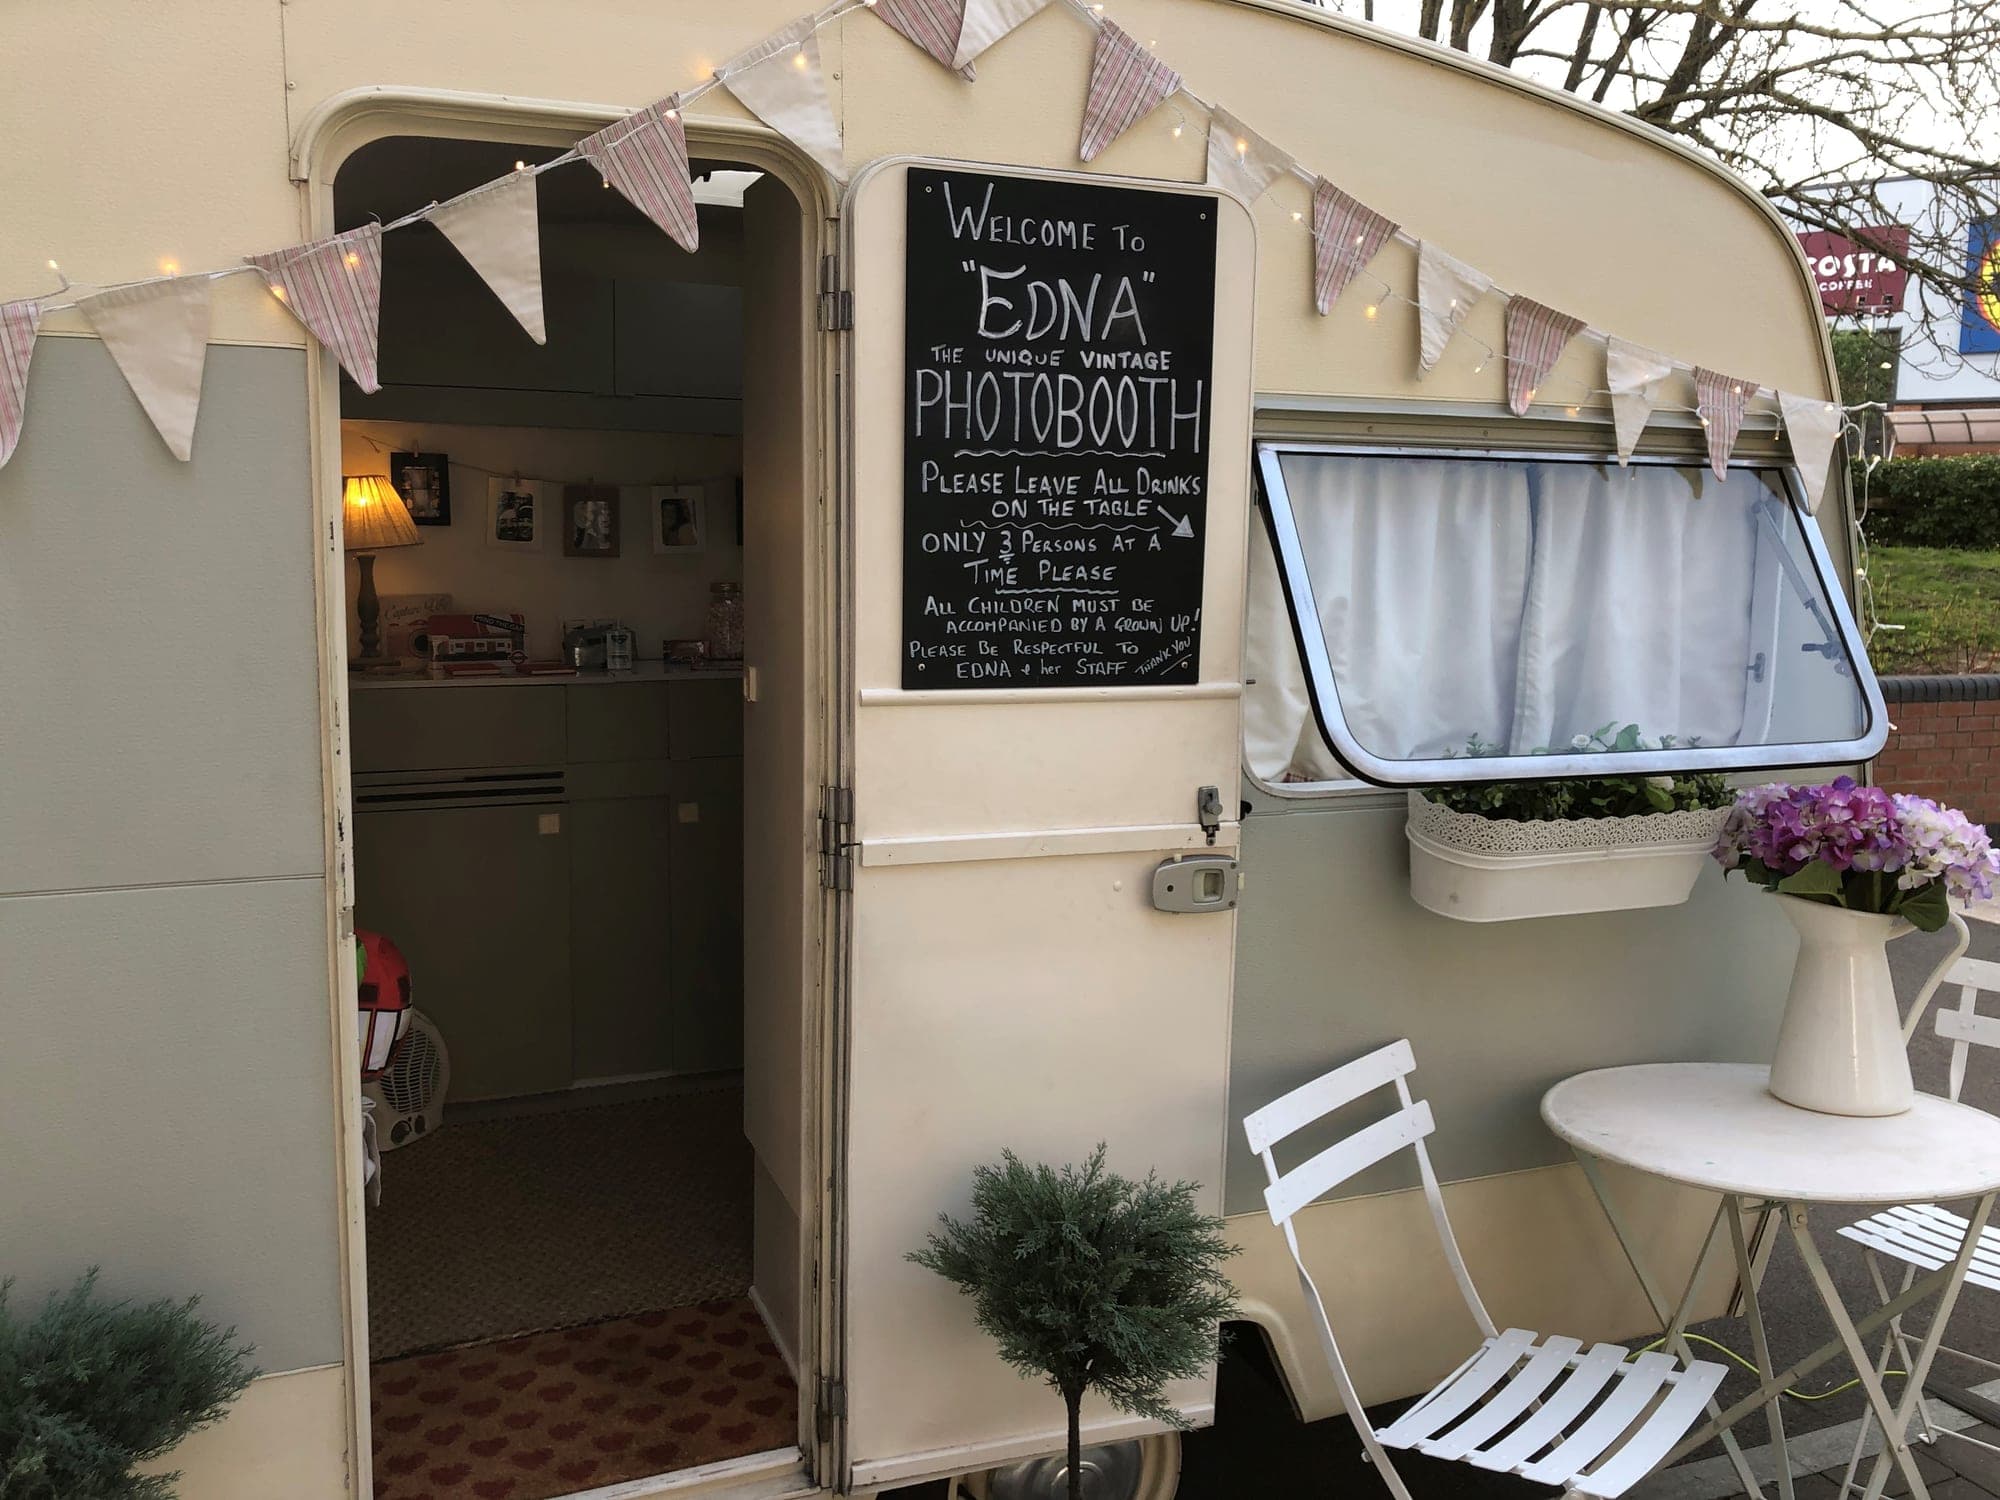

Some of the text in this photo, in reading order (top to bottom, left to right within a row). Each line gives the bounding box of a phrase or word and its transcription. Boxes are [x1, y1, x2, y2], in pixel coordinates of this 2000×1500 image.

[943, 181, 1097, 250] WELCOME
[931, 344, 1172, 370] THE UNIQUE VINTAGE
[915, 369, 1202, 452] PHOTOBOOTH
[921, 460, 1201, 495] PLEASE LEAVE ALL DRINKS
[991, 499, 1152, 518] ON THE TABLE
[922, 530, 1162, 553] ONLY 3 PERSONS AT A
[964, 559, 1117, 585] TIME PLEASE
[924, 595, 1155, 616] ALL CHILDREN MUST BE
[946, 607, 1200, 634] ACCOMPANIED BY A GROWN UP!
[910, 641, 966, 658] PLEASE
[979, 641, 999, 656] BE
[1014, 639, 1103, 655] RESPECTFUL
[1135, 637, 1191, 675] THANK YOU
[957, 661, 1011, 679] EDNA
[1041, 661, 1061, 675] her
[1076, 660, 1127, 675] STAFF
